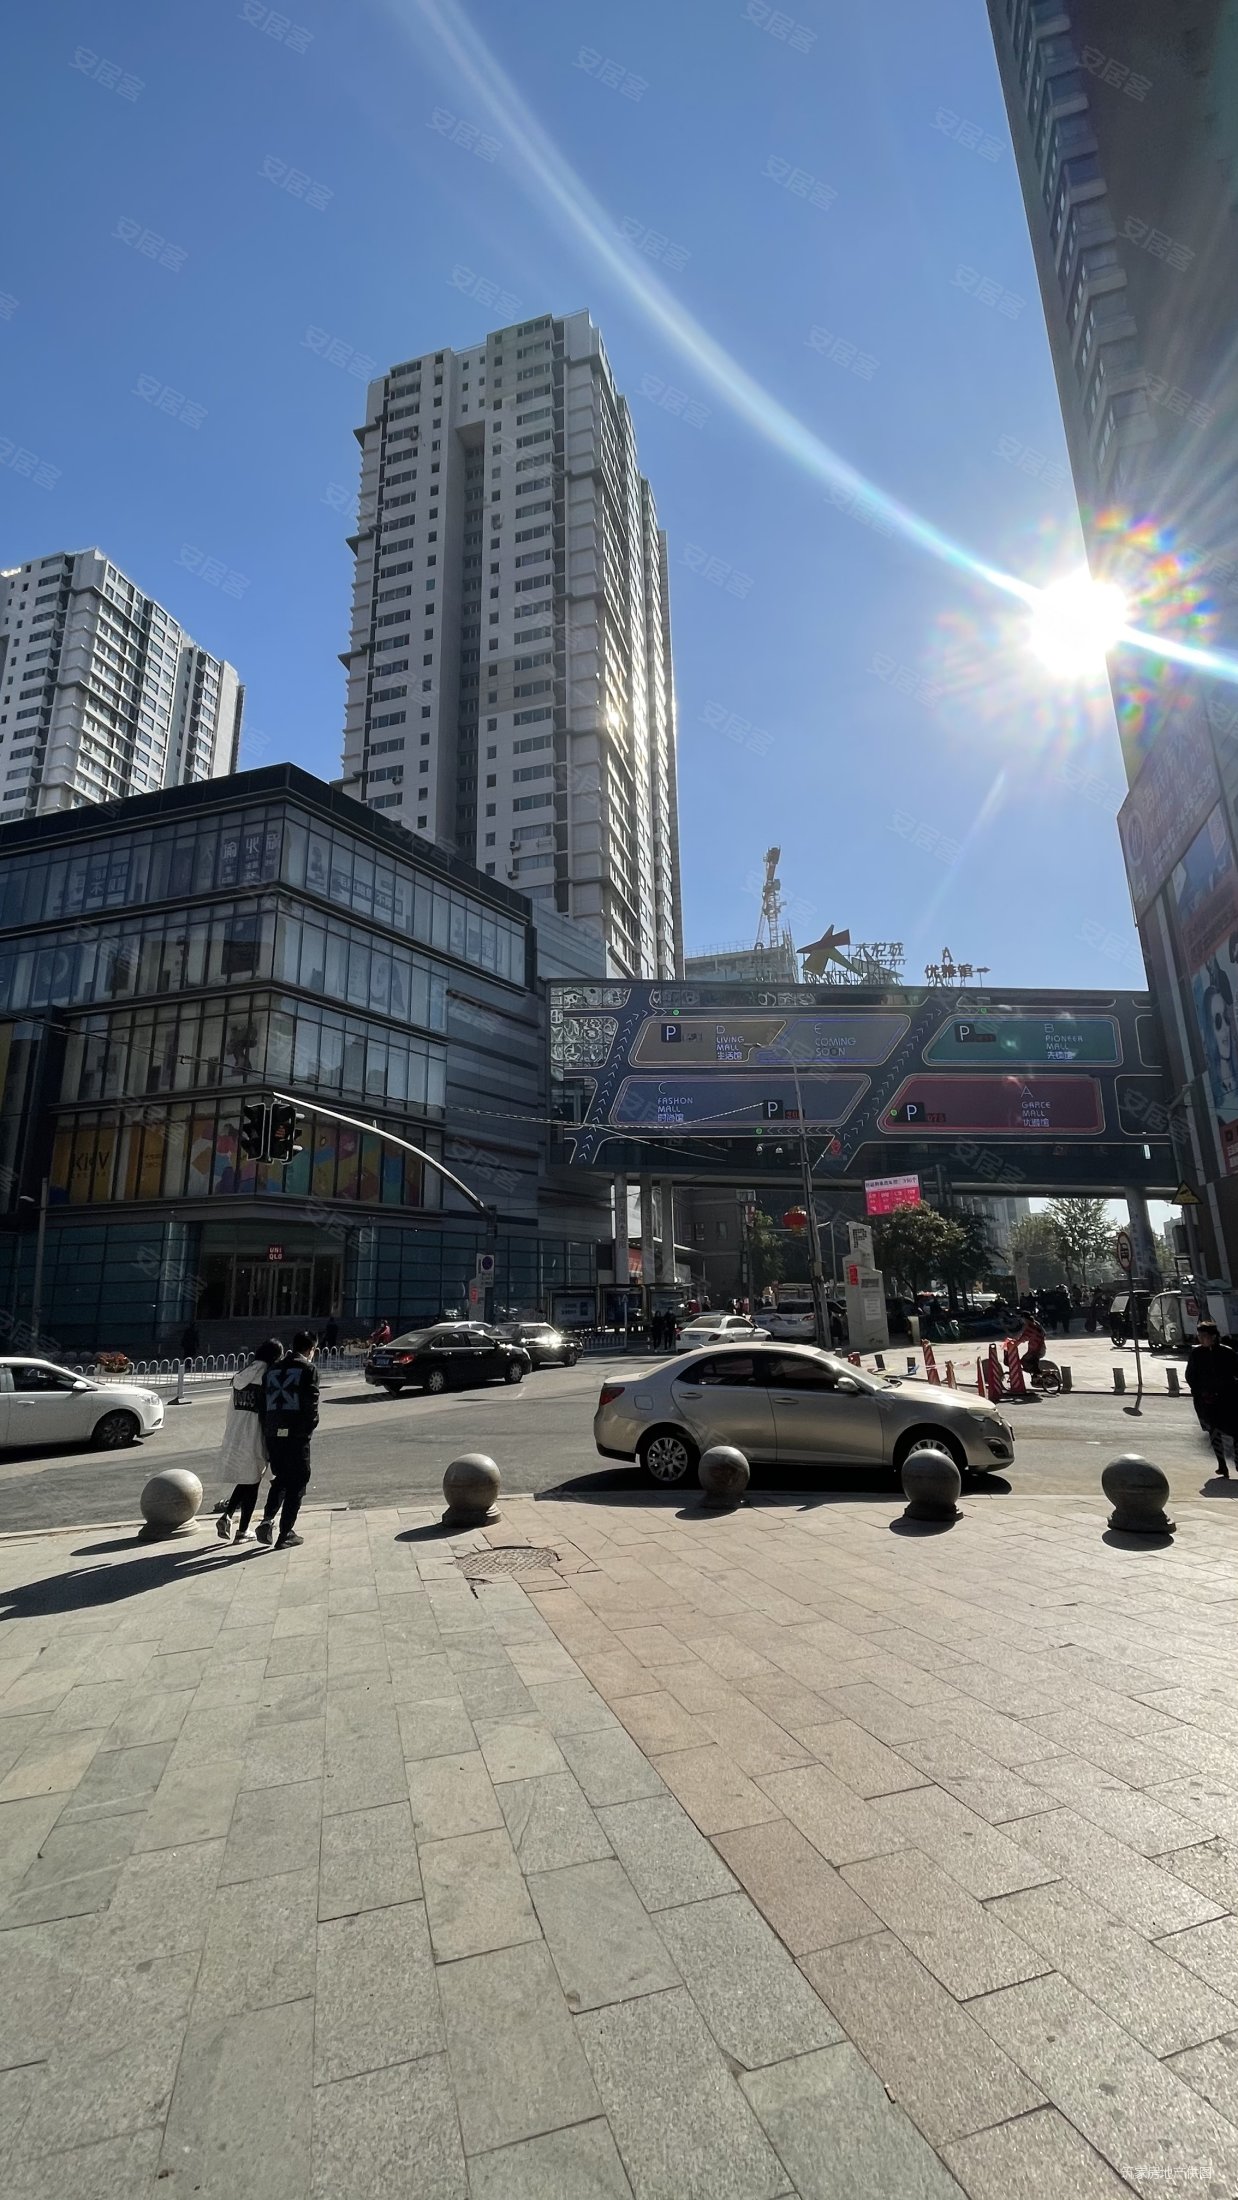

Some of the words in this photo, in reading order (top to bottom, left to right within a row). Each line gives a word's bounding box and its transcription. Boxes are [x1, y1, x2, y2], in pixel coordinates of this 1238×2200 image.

[942, 947, 953, 963] A
[924, 964, 973, 978] 优雅馆
[666, 1025, 676, 1041] P
[716, 1025, 725, 1034] D
[814, 1023, 822, 1035] E
[959, 1026, 970, 1041] P
[1044, 1024, 1054, 1033] B
[716, 1036, 744, 1044] LIVING
[815, 1037, 856, 1047] COMING
[1045, 1035, 1083, 1043] PIONEER
[717, 1051, 743, 1061] 生活馆
[815, 1048, 846, 1057] SOON
[1020, 1085, 1033, 1098] A
[657, 1097, 693, 1105] FASHON
[657, 1105, 681, 1113] MALL
[768, 1101, 778, 1118] P
[906, 1104, 917, 1121] P
[1022, 1109, 1045, 1117] MALL
[852, 1228, 868, 1249] P
